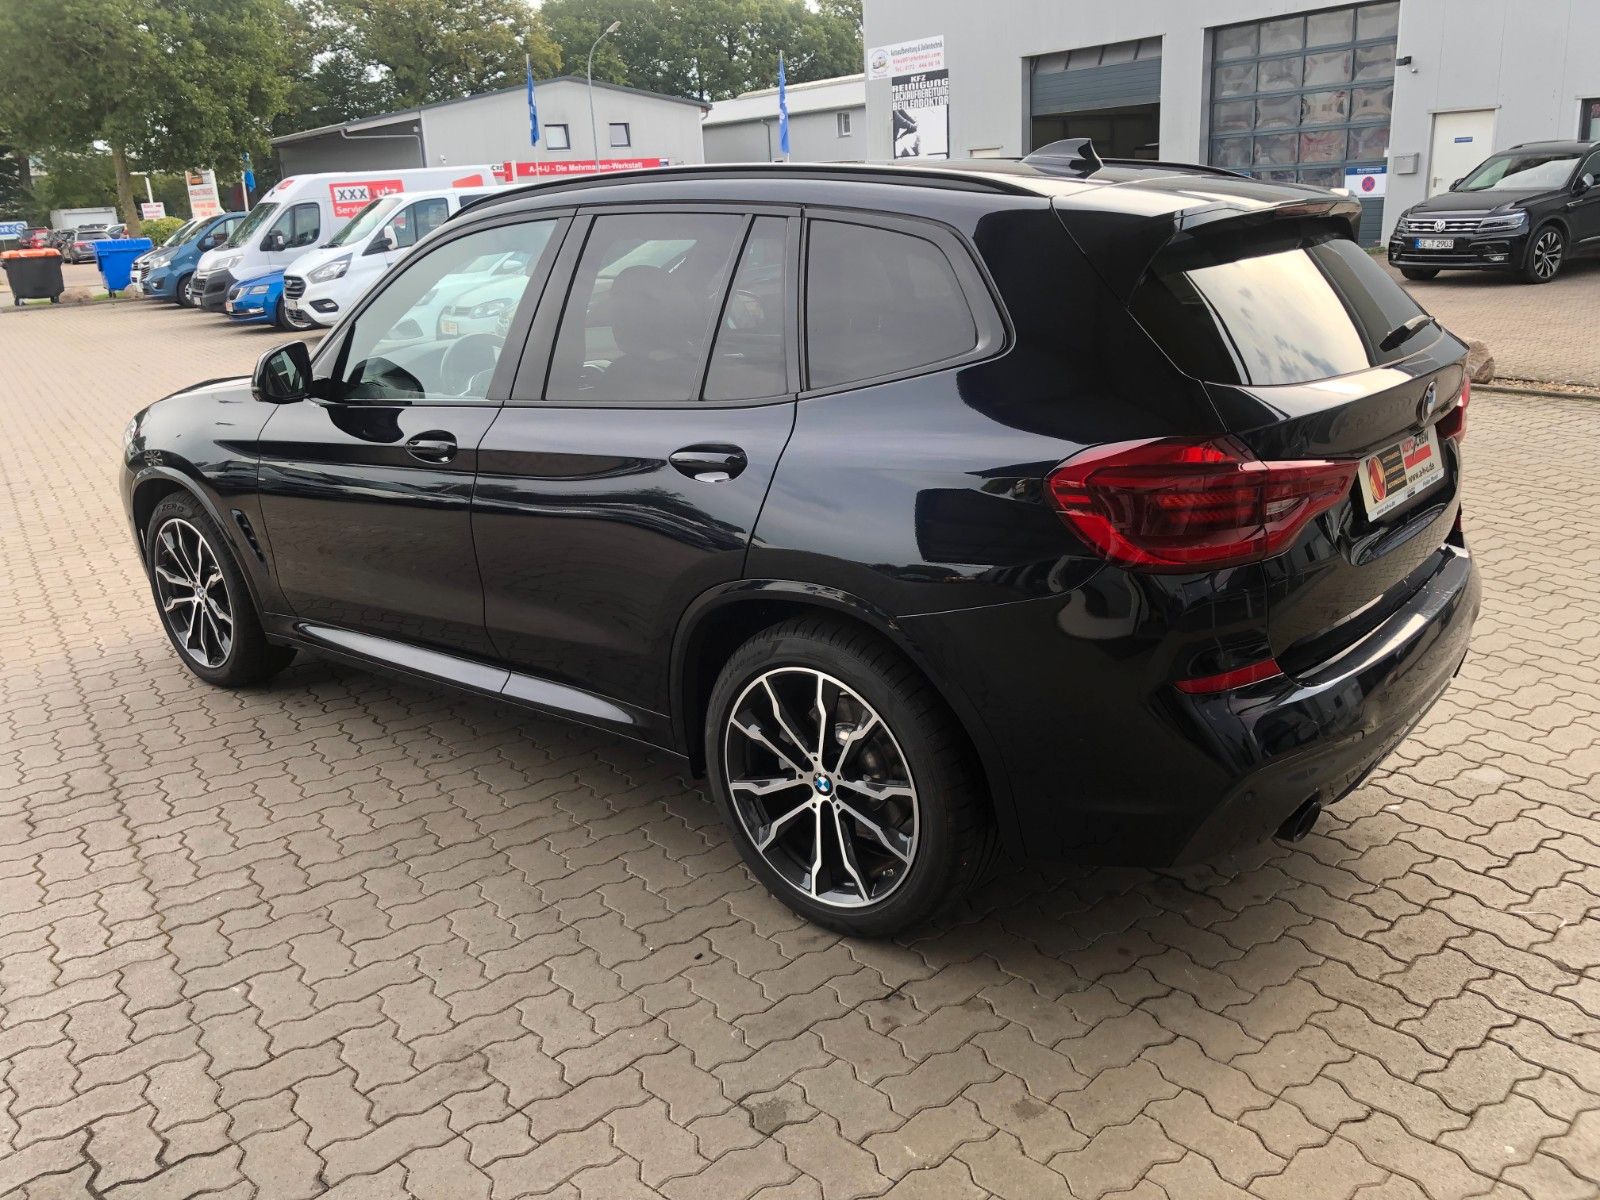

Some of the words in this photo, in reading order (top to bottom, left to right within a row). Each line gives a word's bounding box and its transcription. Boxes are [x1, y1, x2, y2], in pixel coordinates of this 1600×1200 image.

[892, 78, 949, 92] REINIGUNG
[892, 86, 949, 101] LACKAUFBEREITUNG
[892, 96, 949, 111] BEULENDOKTOR
[555, 164, 568, 172] Die
[568, 161, 643, 172] Mehrmaken-Werkstatt
